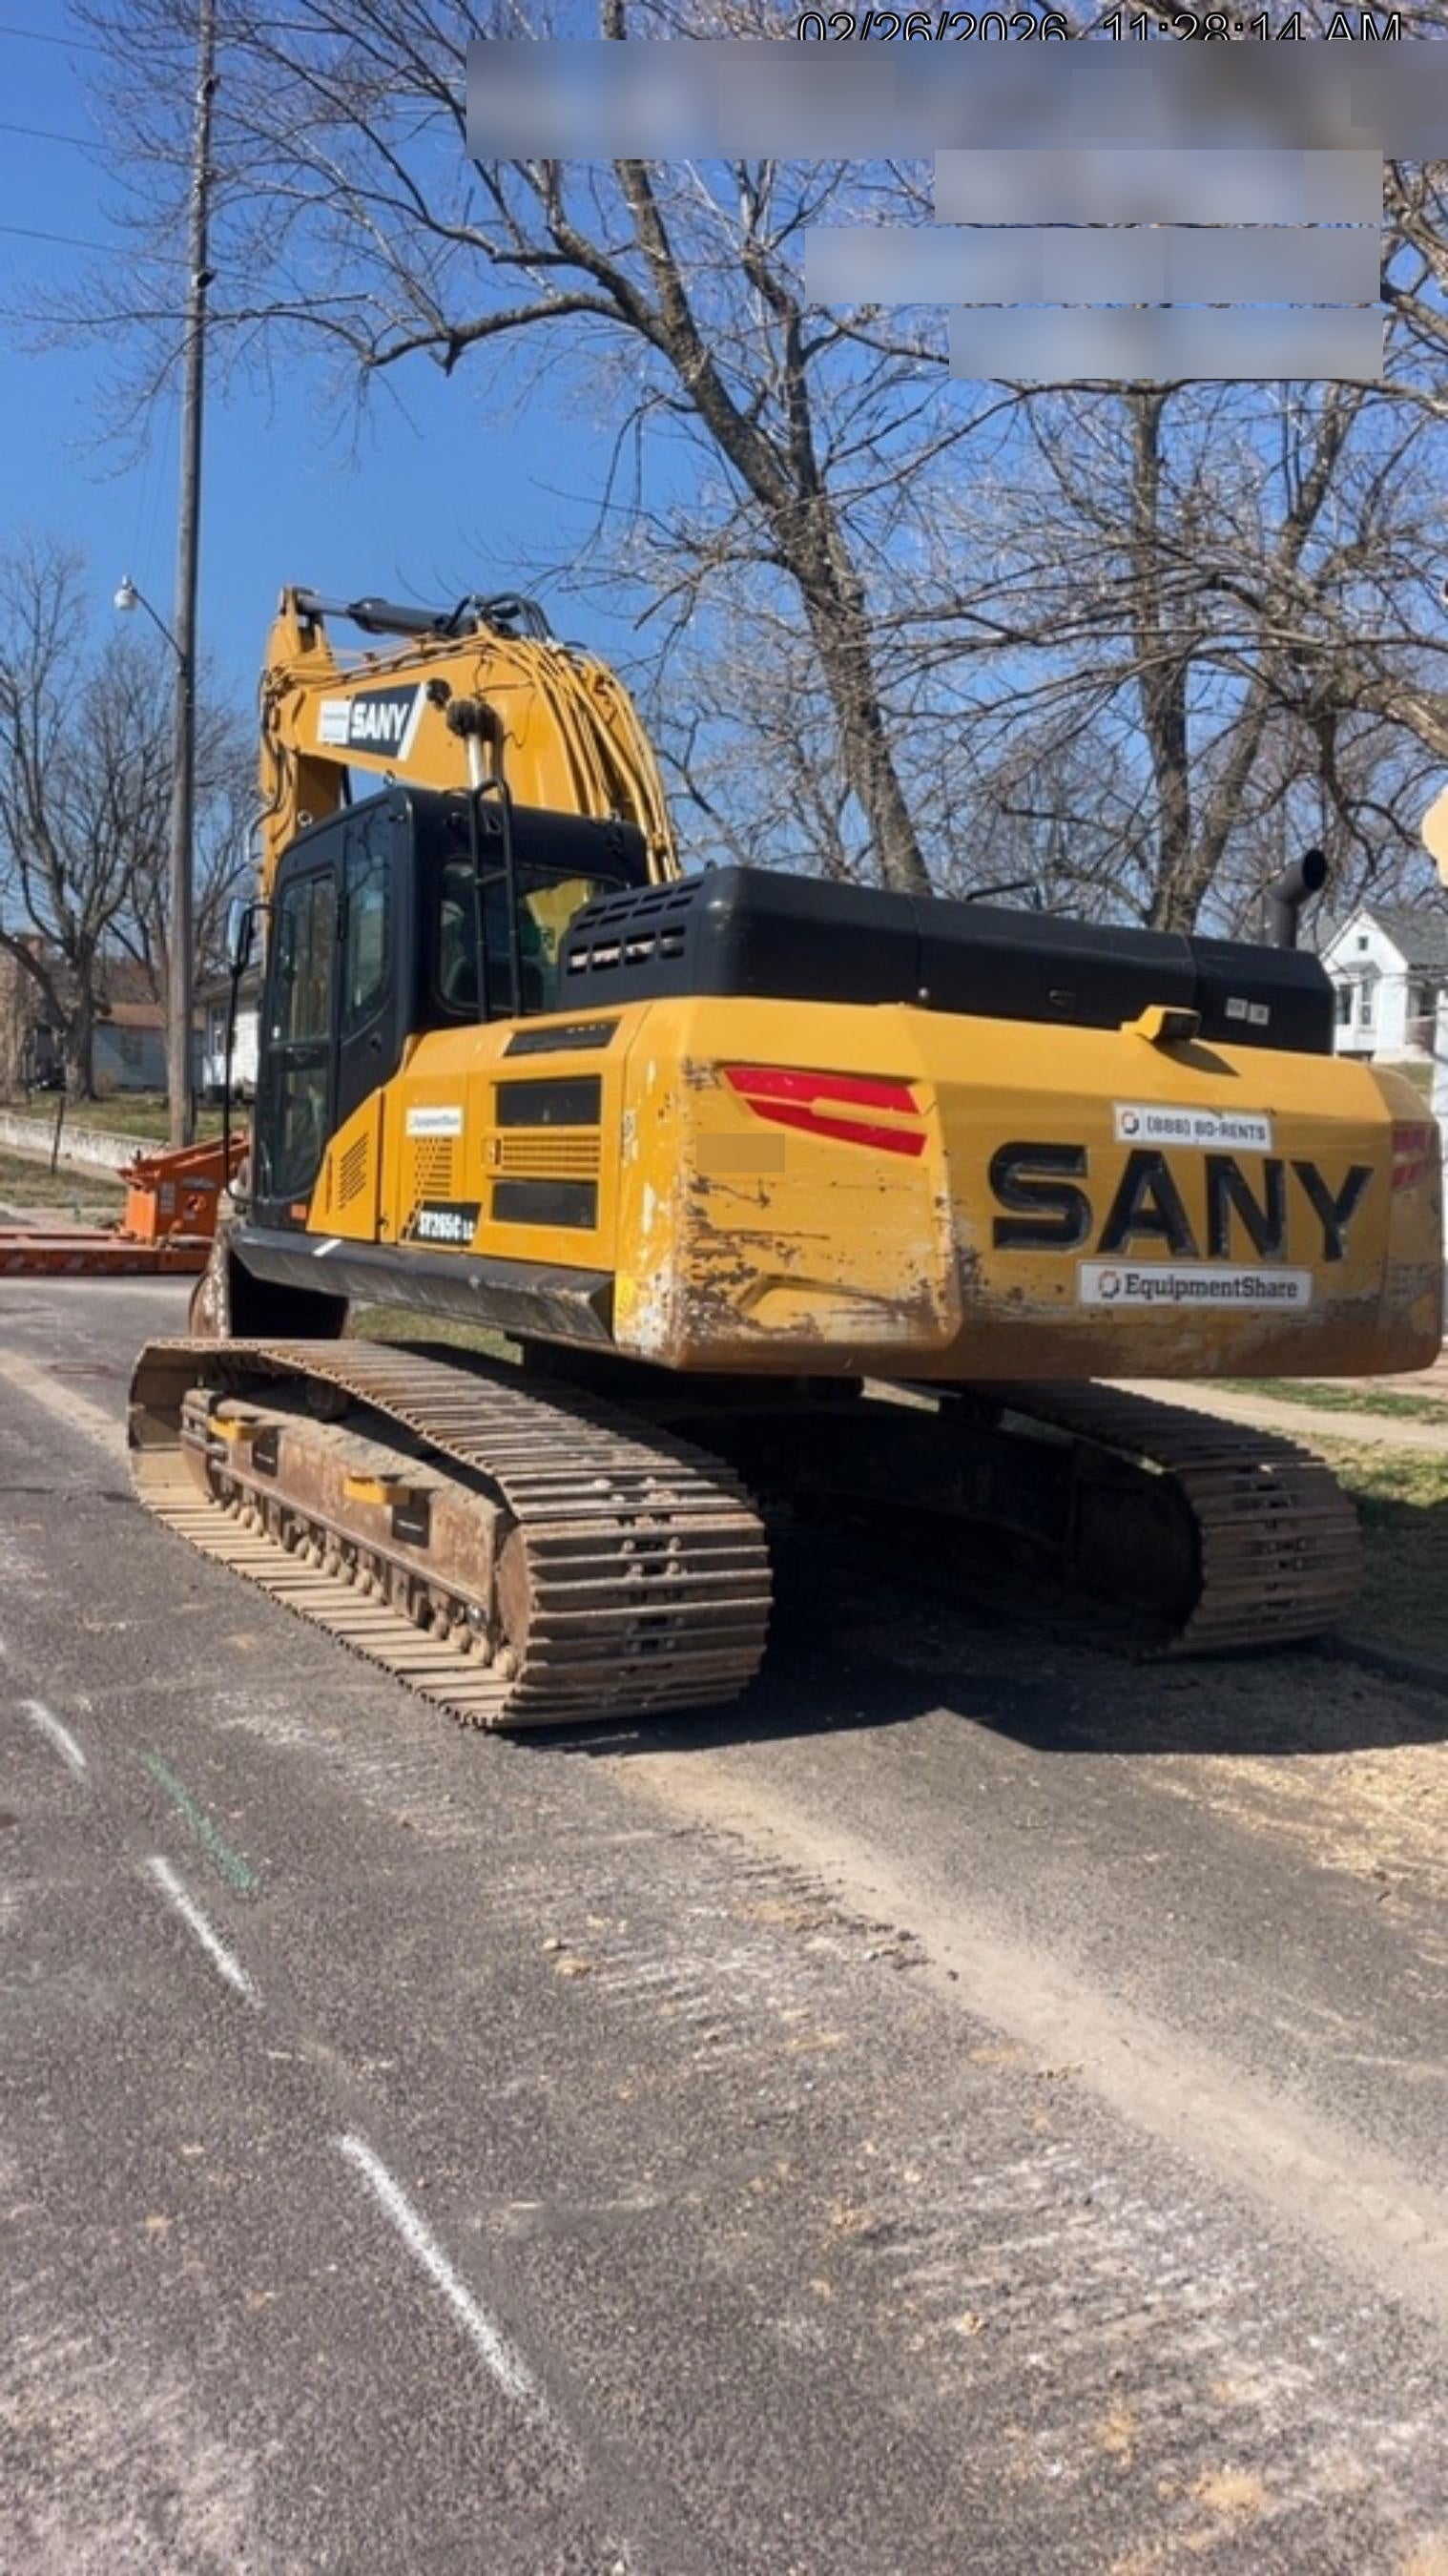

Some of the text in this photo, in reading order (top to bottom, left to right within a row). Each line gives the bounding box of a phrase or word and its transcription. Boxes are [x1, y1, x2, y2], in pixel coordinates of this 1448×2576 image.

[351, 701, 410, 741] SANY
[1147, 1114, 1191, 1137] (888)
[987, 1140, 1375, 1262] SANY
[1124, 1273, 1298, 1300] EquipmentShare
